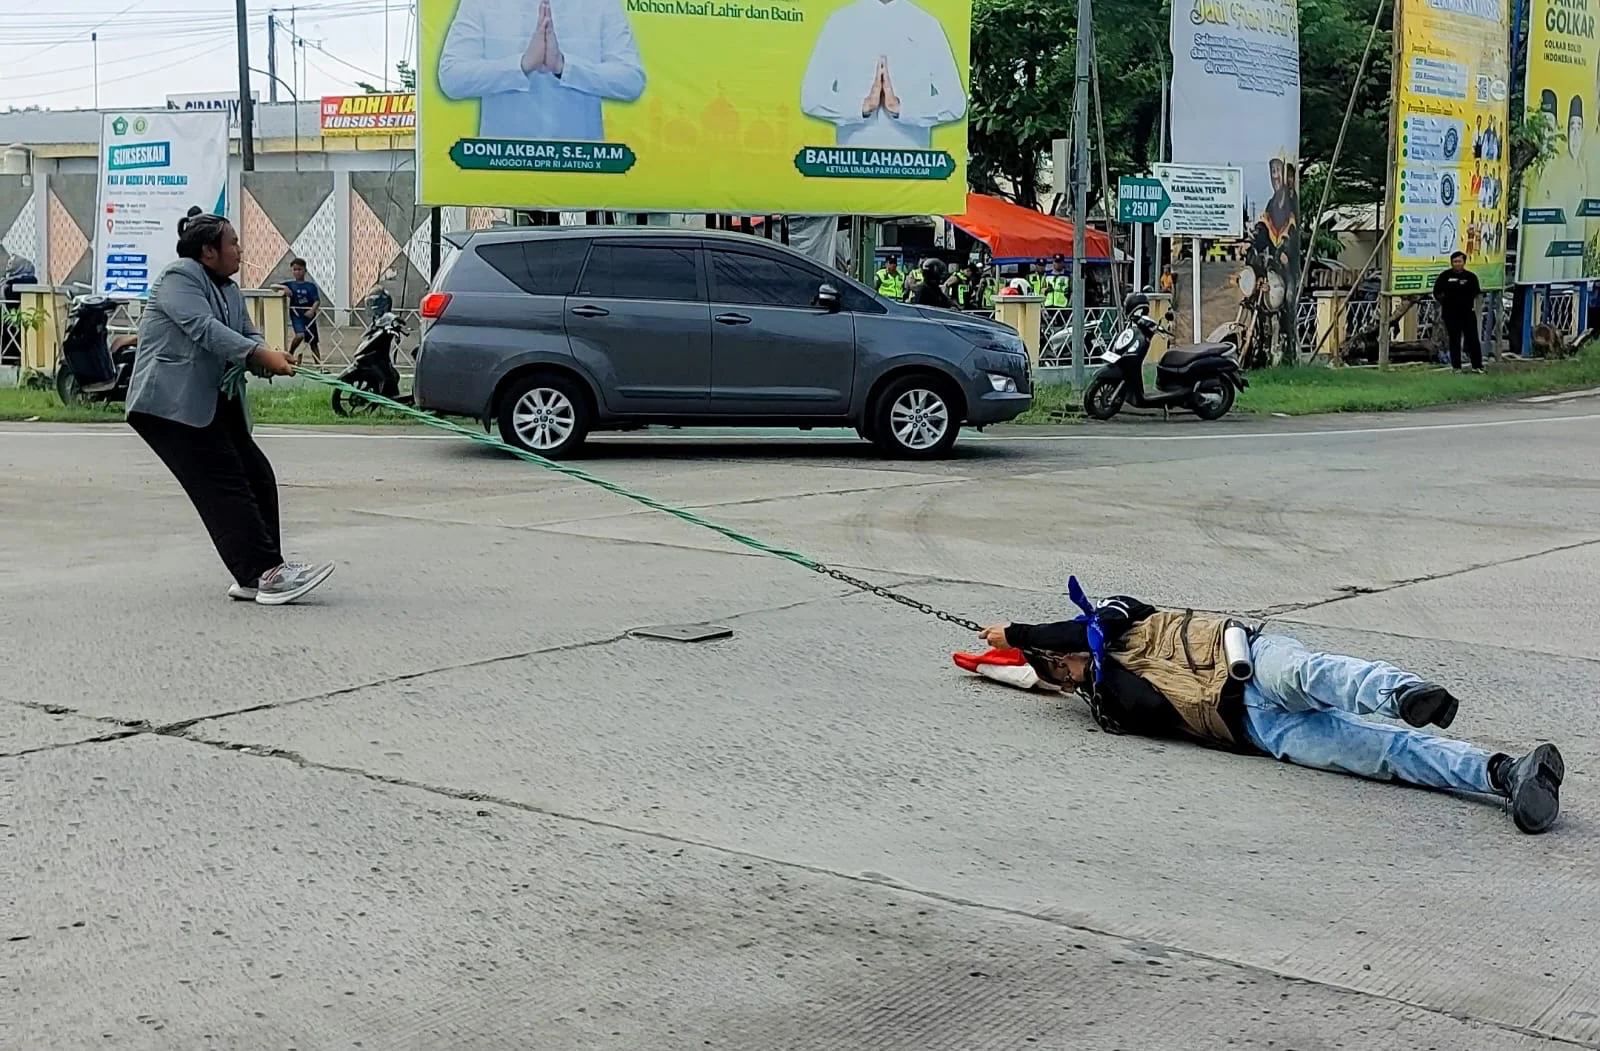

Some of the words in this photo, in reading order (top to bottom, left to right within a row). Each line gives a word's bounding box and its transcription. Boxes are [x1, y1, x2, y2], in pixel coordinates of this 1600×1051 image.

[626, 0, 674, 14] Mohon
[675, 0, 711, 16] Maaf
[710, 2, 744, 17] Lahir
[745, 5, 770, 20] dan
[770, 7, 804, 22] Batin
[1545, 7, 1595, 40] GOLKAR
[339, 96, 388, 115] ADHI
[324, 115, 377, 128] KURSUS
[378, 114, 416, 127] SETIR
[463, 143, 501, 156] DONI
[504, 144, 560, 158] AKBAR,
[562, 146, 591, 160] S.E.,
[593, 147, 623, 160] M.M
[805, 149, 859, 166] BAHLIL
[862, 151, 947, 168] LAHADALIA
[489, 158, 533, 167] ANGGOTA
[534, 160, 552, 168] DPR
[553, 160, 561, 168] RI
[562, 161, 595, 169] JATENG
[595, 161, 601, 169] X
[825, 165, 850, 174] KETUA
[850, 166, 874, 175] UMUM
[874, 166, 900, 175] PARTAI
[901, 167, 930, 175] GOLKAR
[1132, 201, 1149, 217] 250
[1149, 202, 1157, 217] M
